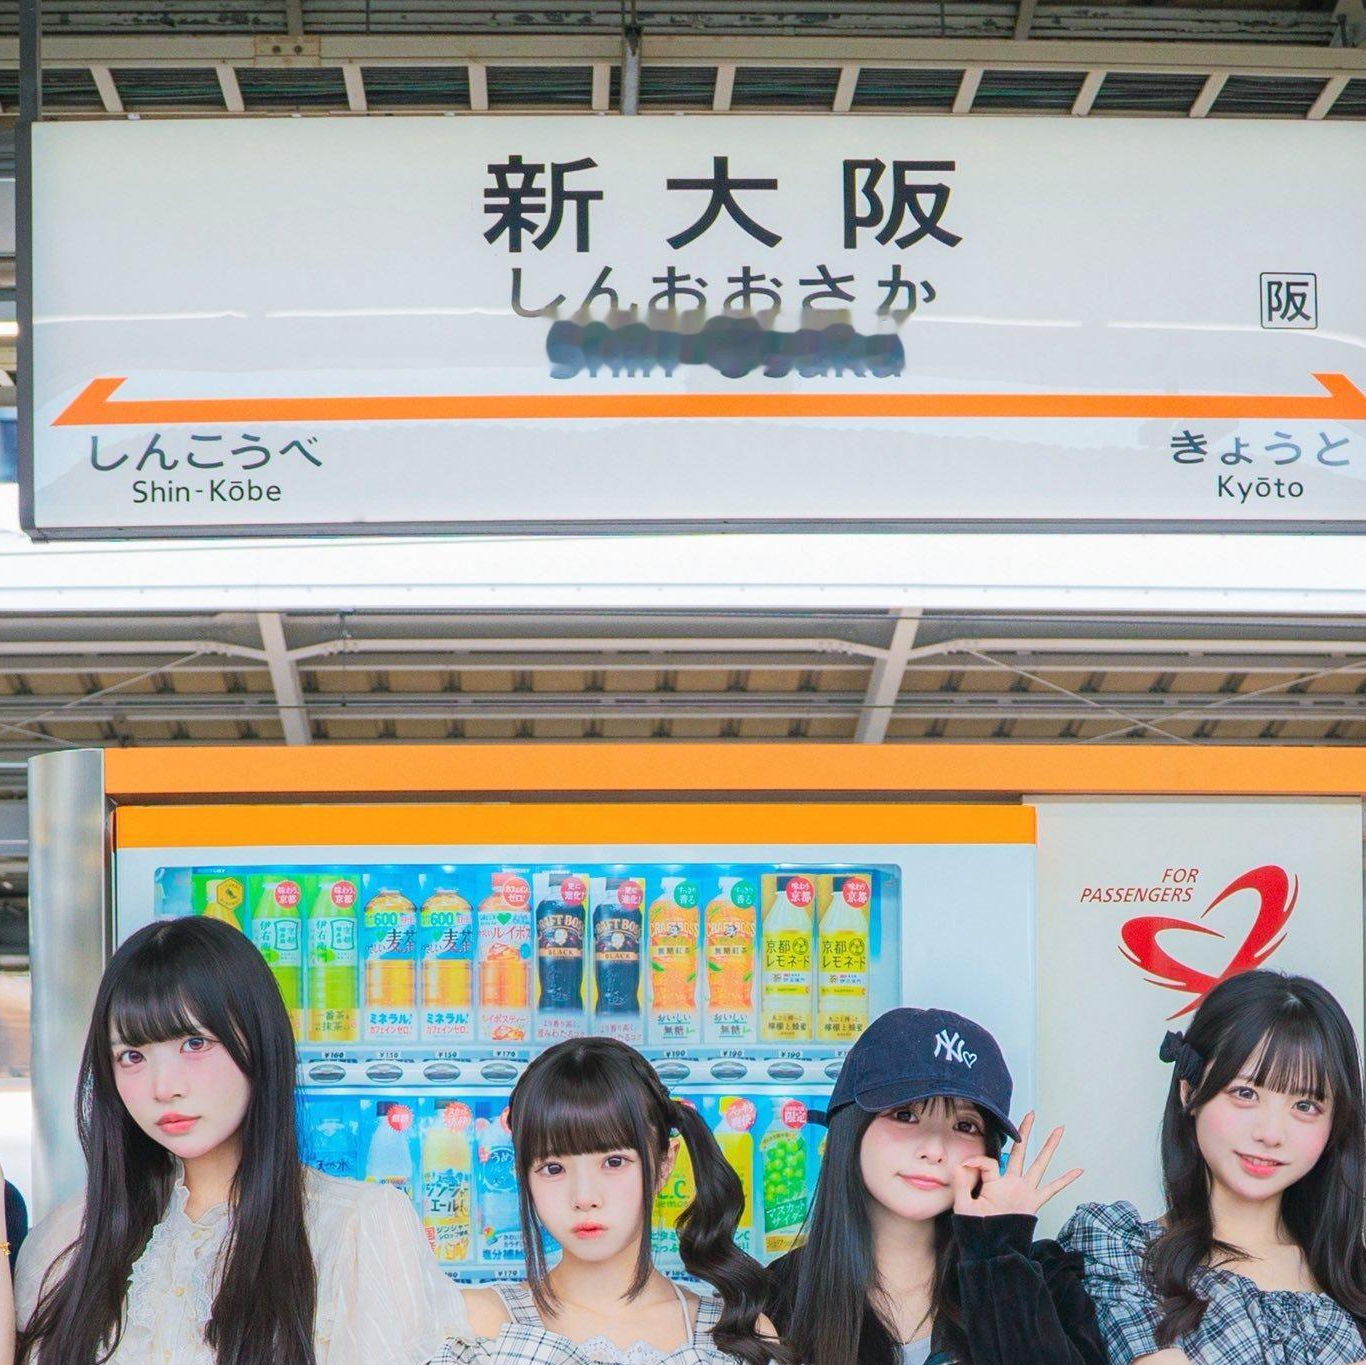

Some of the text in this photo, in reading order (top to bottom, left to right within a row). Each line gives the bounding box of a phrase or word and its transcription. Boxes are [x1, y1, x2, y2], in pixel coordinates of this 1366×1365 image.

[483, 154, 964, 253] 新大阪
[1267, 280, 1312, 322] 阪
[90, 432, 323, 472] しんこうべ
[1170, 429, 1350, 467] きょうと
[132, 479, 282, 504] Shin-Kōbe
[1218, 475, 1304, 504] Kyōto
[1161, 867, 1200, 884] FOR
[1079, 886, 1194, 903] PASSENGERS
[766, 940, 791, 954] 京都
[822, 940, 847, 954] 京都
[765, 955, 810, 969] レモネード
[822, 956, 866, 969] レモネード
[933, 1029, 966, 1063] NY
[766, 1202, 805, 1217] マスカット
